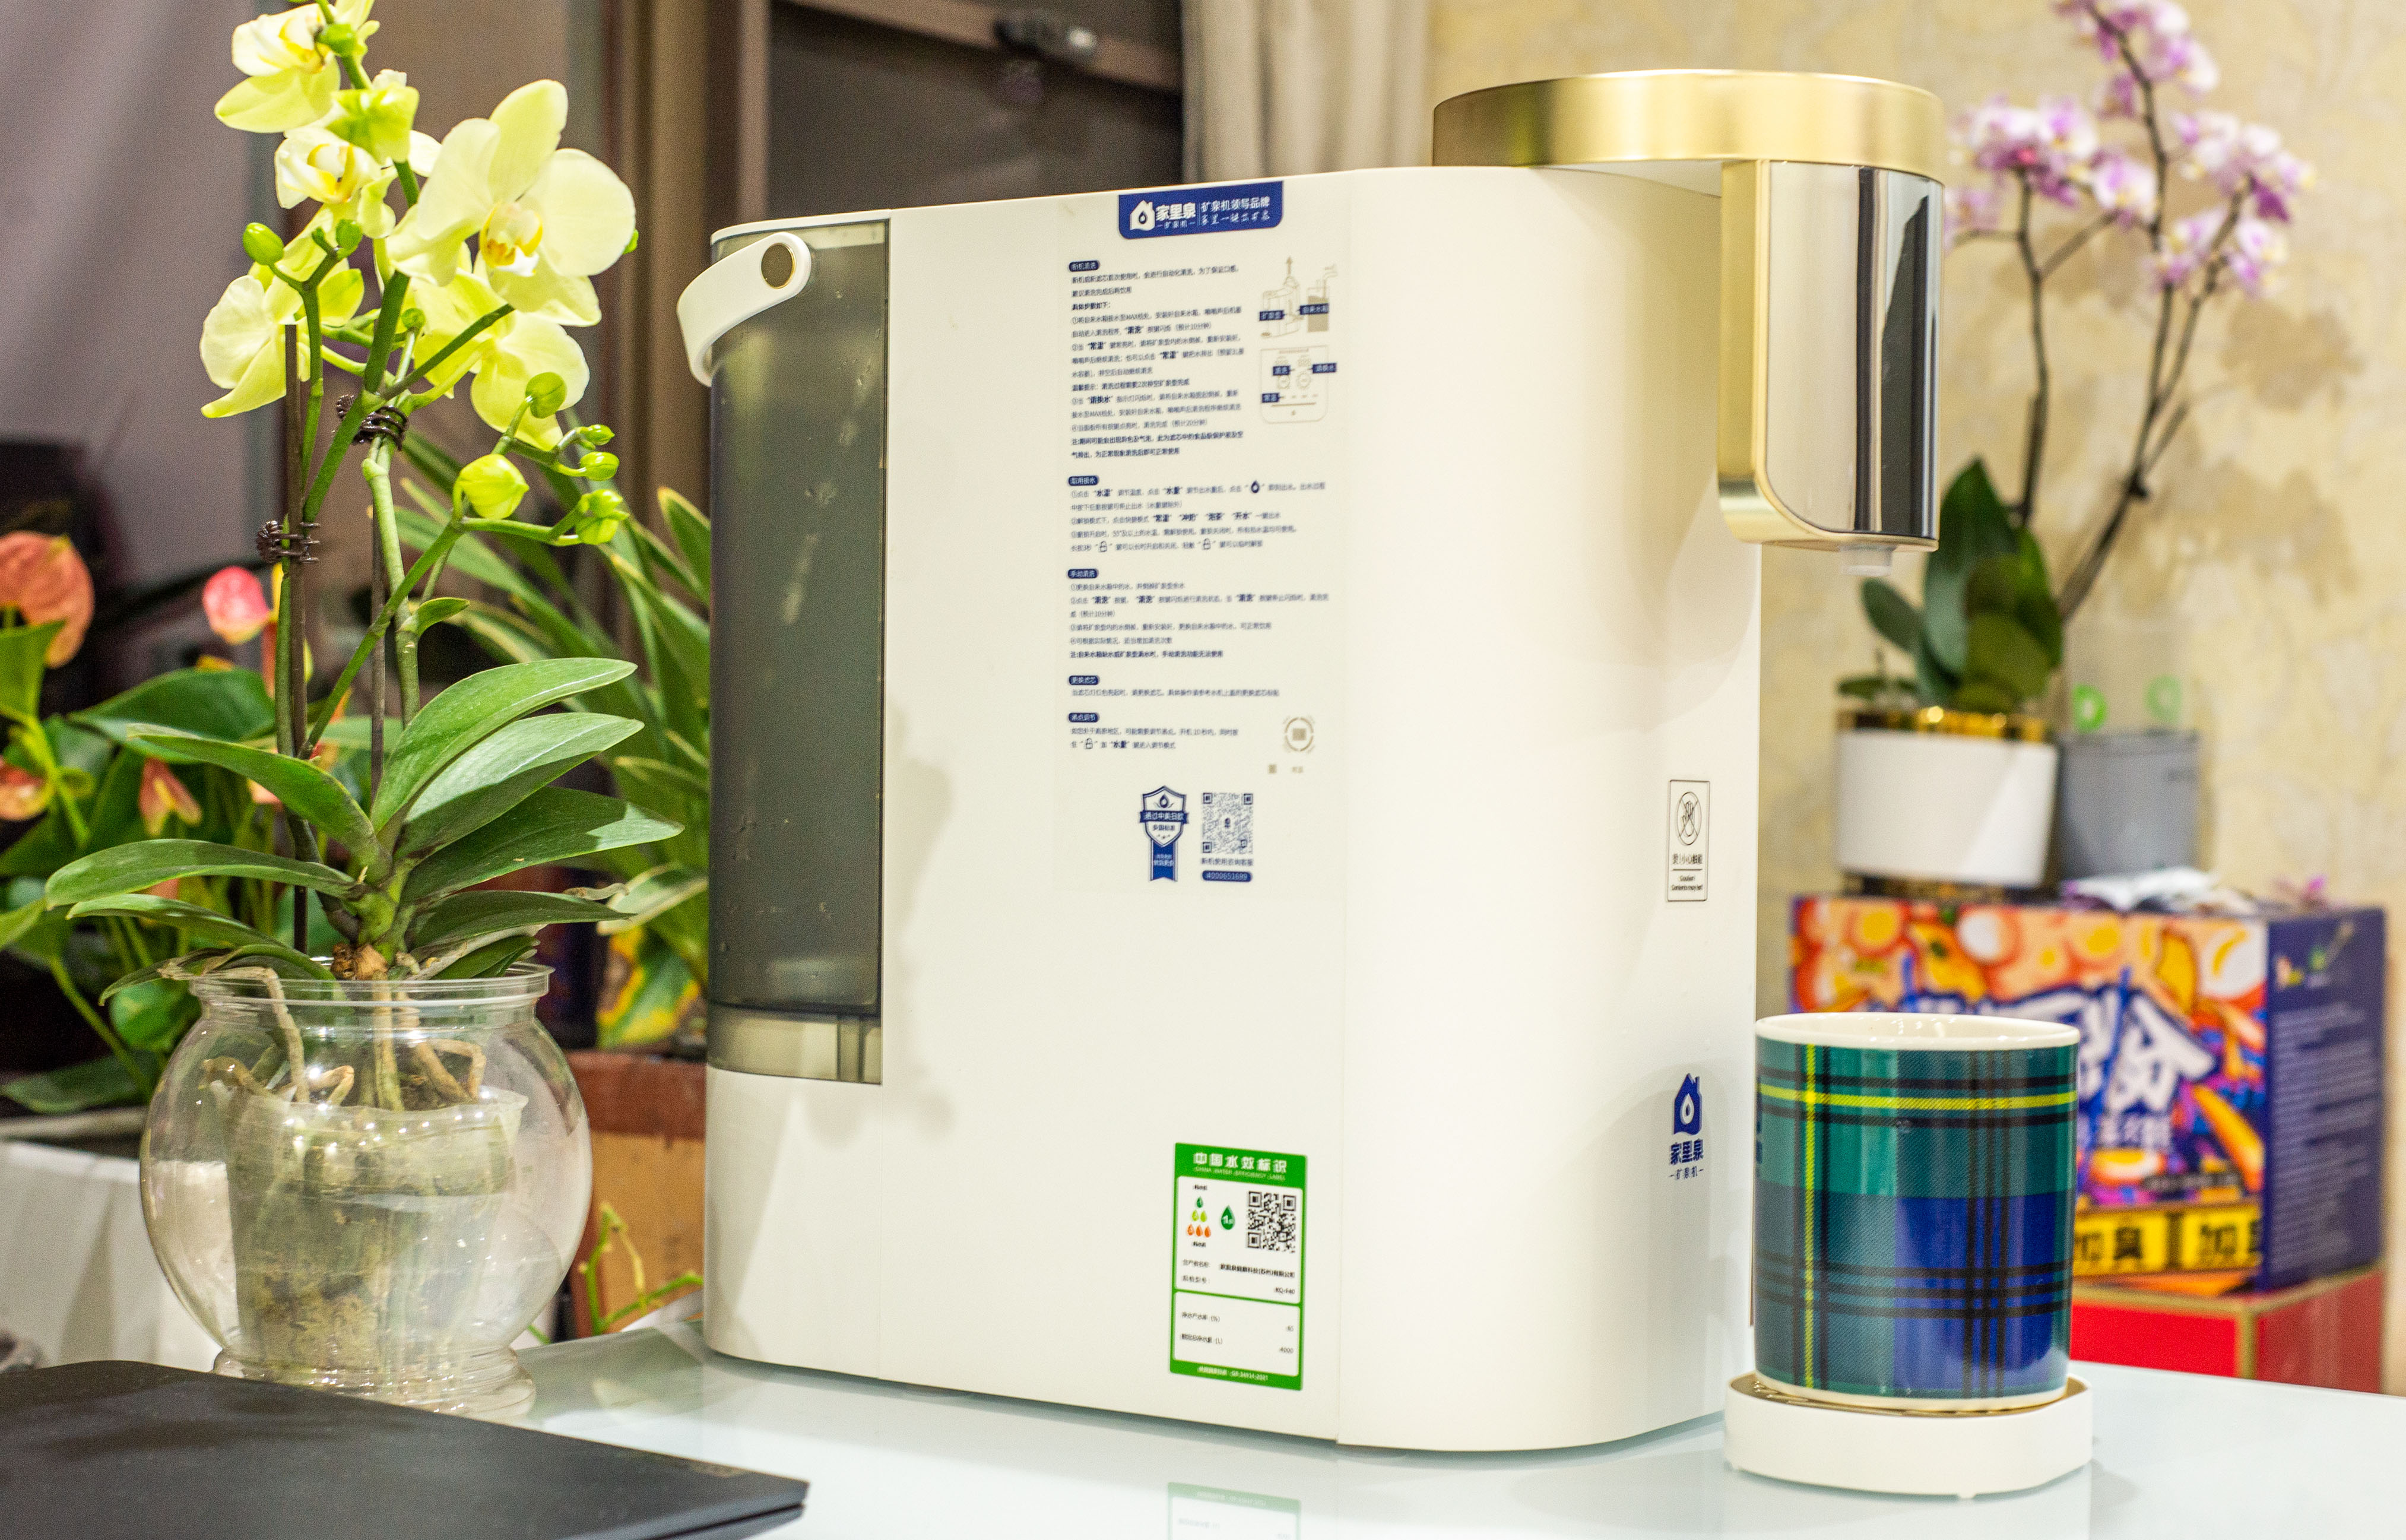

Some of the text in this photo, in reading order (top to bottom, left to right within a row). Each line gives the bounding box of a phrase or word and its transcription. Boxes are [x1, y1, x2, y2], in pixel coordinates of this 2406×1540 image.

[1156, 202, 1196, 221] 家里泉
[1201, 197, 1270, 213] 矿泉机领导品牌
[1072, 262, 1097, 271] 新机清洗
[1670, 1139, 1704, 1165] 家里泉
[1193, 1152, 1287, 1174] 中国水效标识
[1676, 1166, 1698, 1180] 矿泉机
